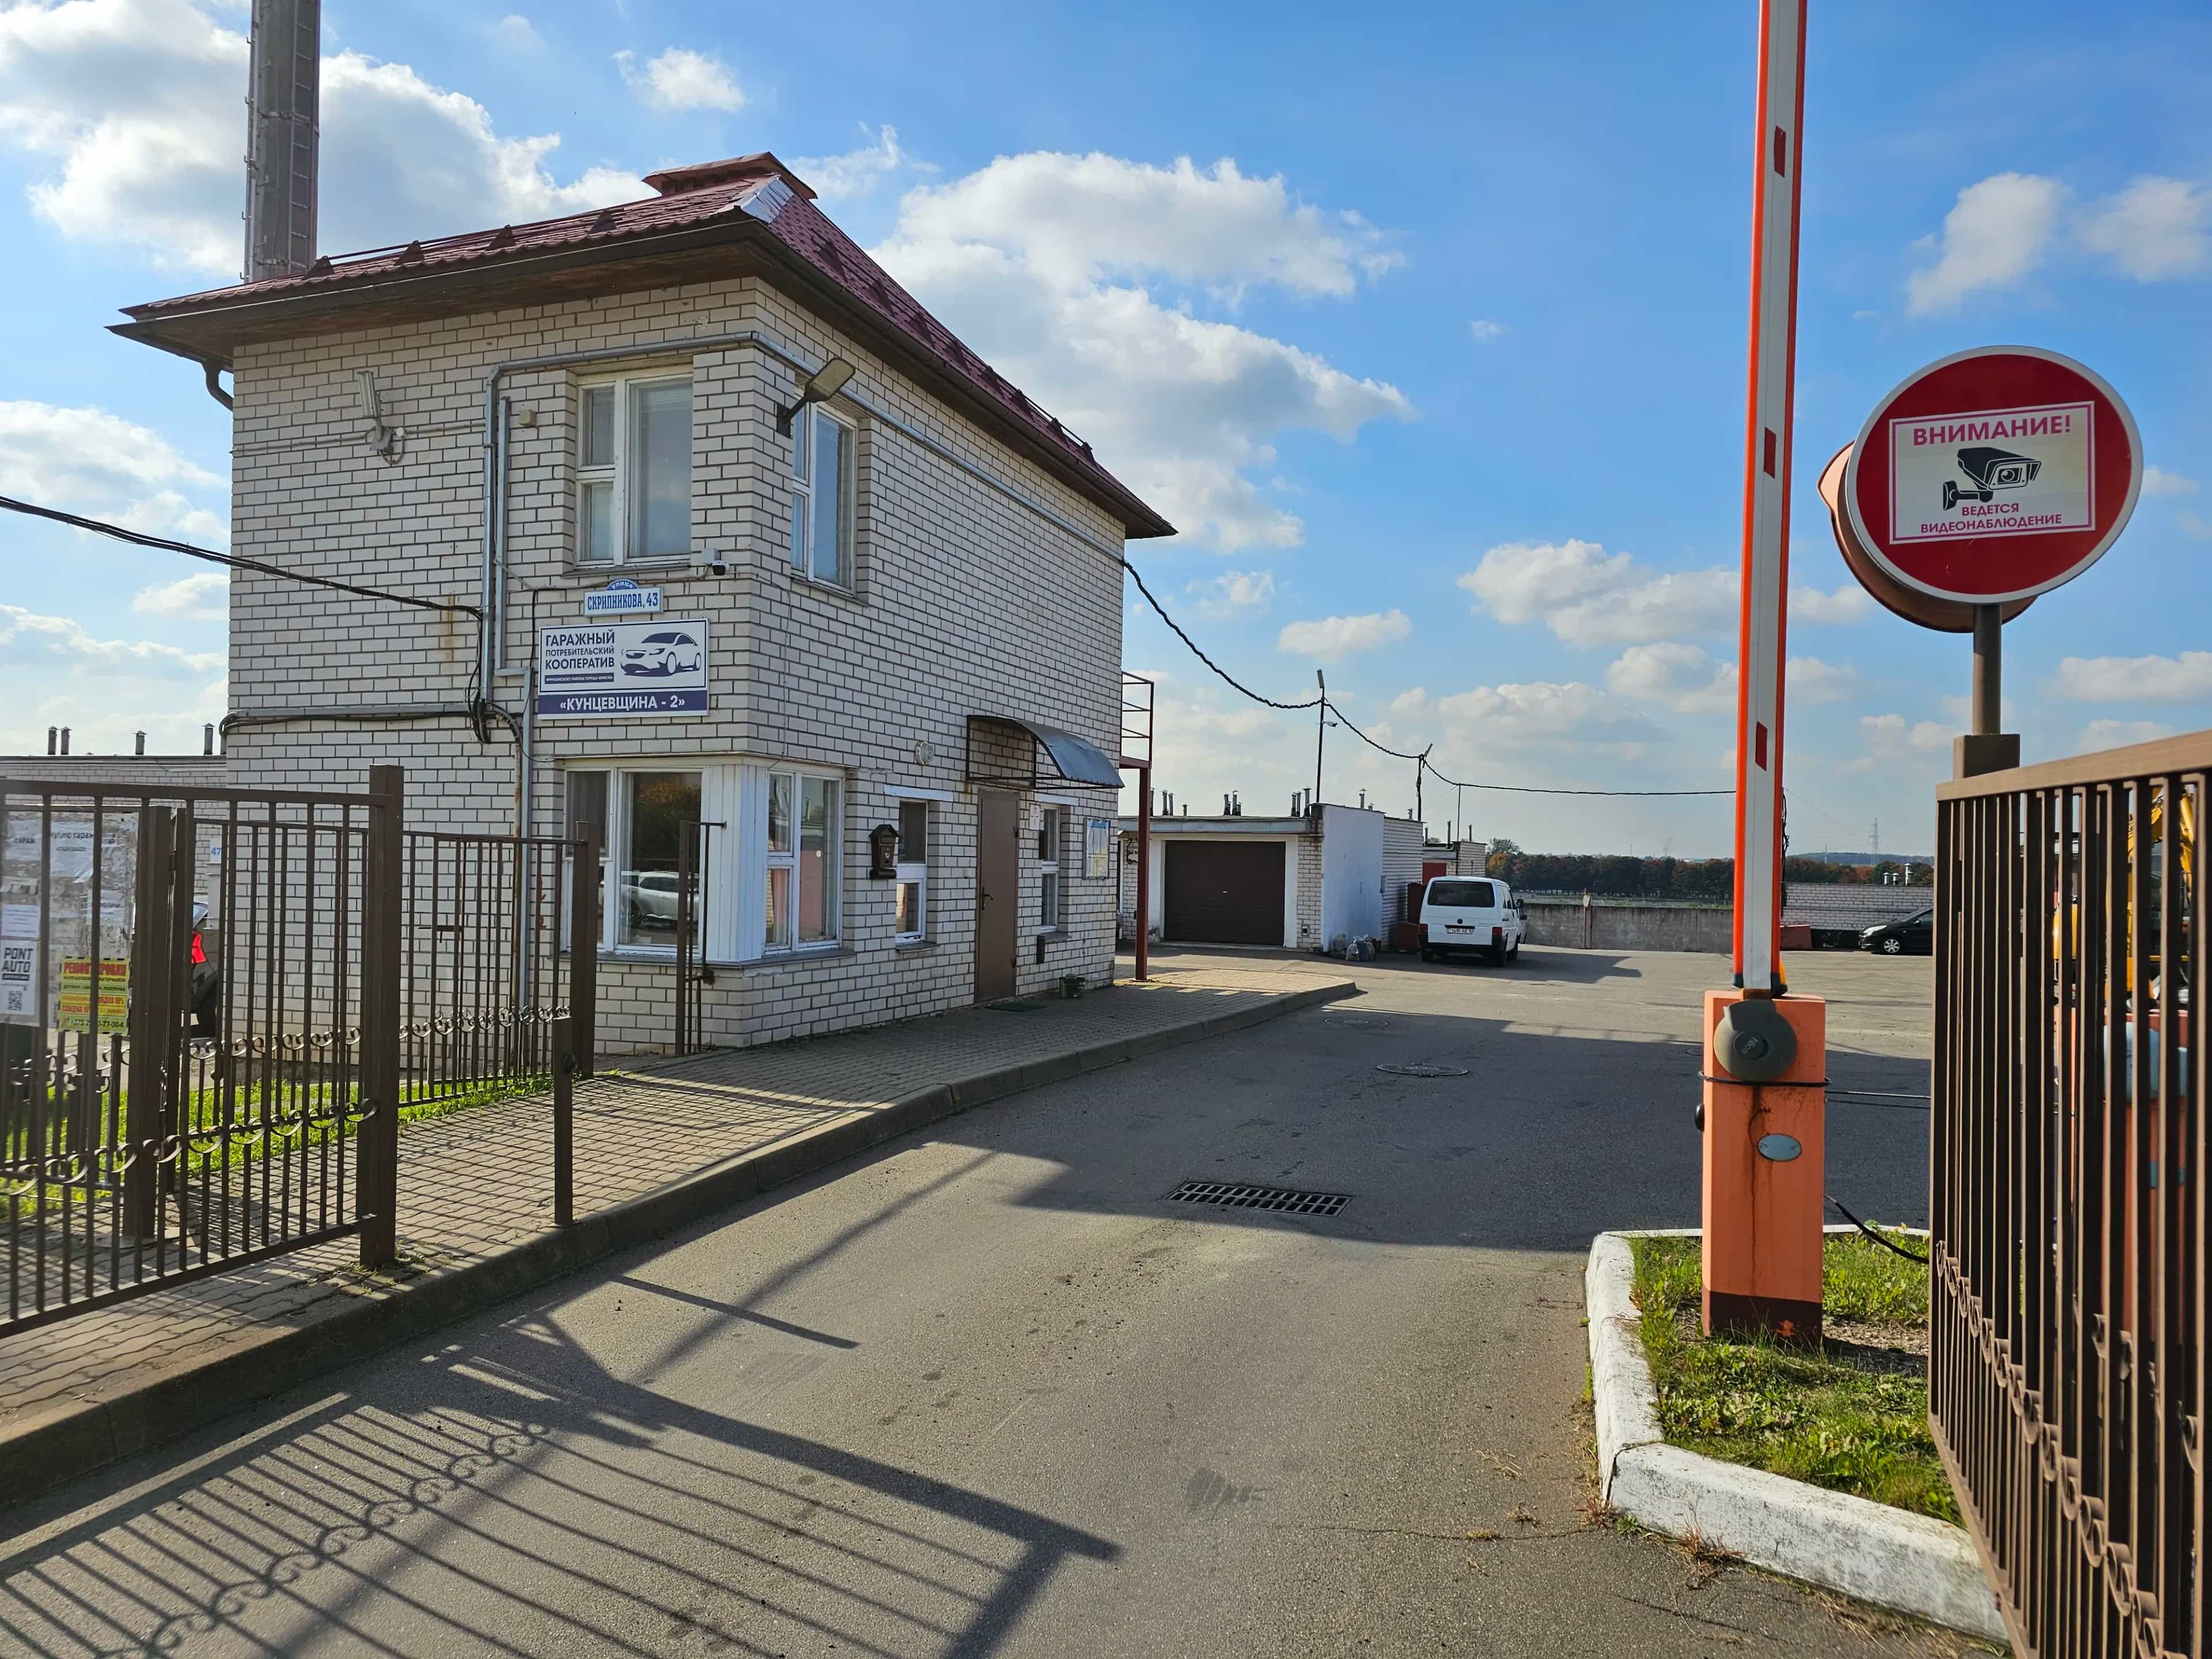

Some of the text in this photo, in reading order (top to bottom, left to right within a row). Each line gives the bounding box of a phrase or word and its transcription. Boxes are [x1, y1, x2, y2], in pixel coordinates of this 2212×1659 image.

[1913, 414, 2071, 446] ВНИМАНИЕ!
[1962, 503, 2019, 517] ВЕДЕТСЯ
[1921, 514, 2062, 533] ВИДЕОНАБЛЮДЕНИЕ
[588, 593, 658, 610] СКРИПНИКОВА, 43
[546, 628, 615, 646] ГАРАЖНЫЙ
[546, 645, 614, 657] ПОТРЕБИТЕЛЬСКИЙ
[545, 657, 615, 670] КООПЕРАТИВ
[560, 695, 658, 712] «КУНЦЕВЩИНА
[4, 948, 34, 960] PONT
[1, 960, 31, 973] AUTO
